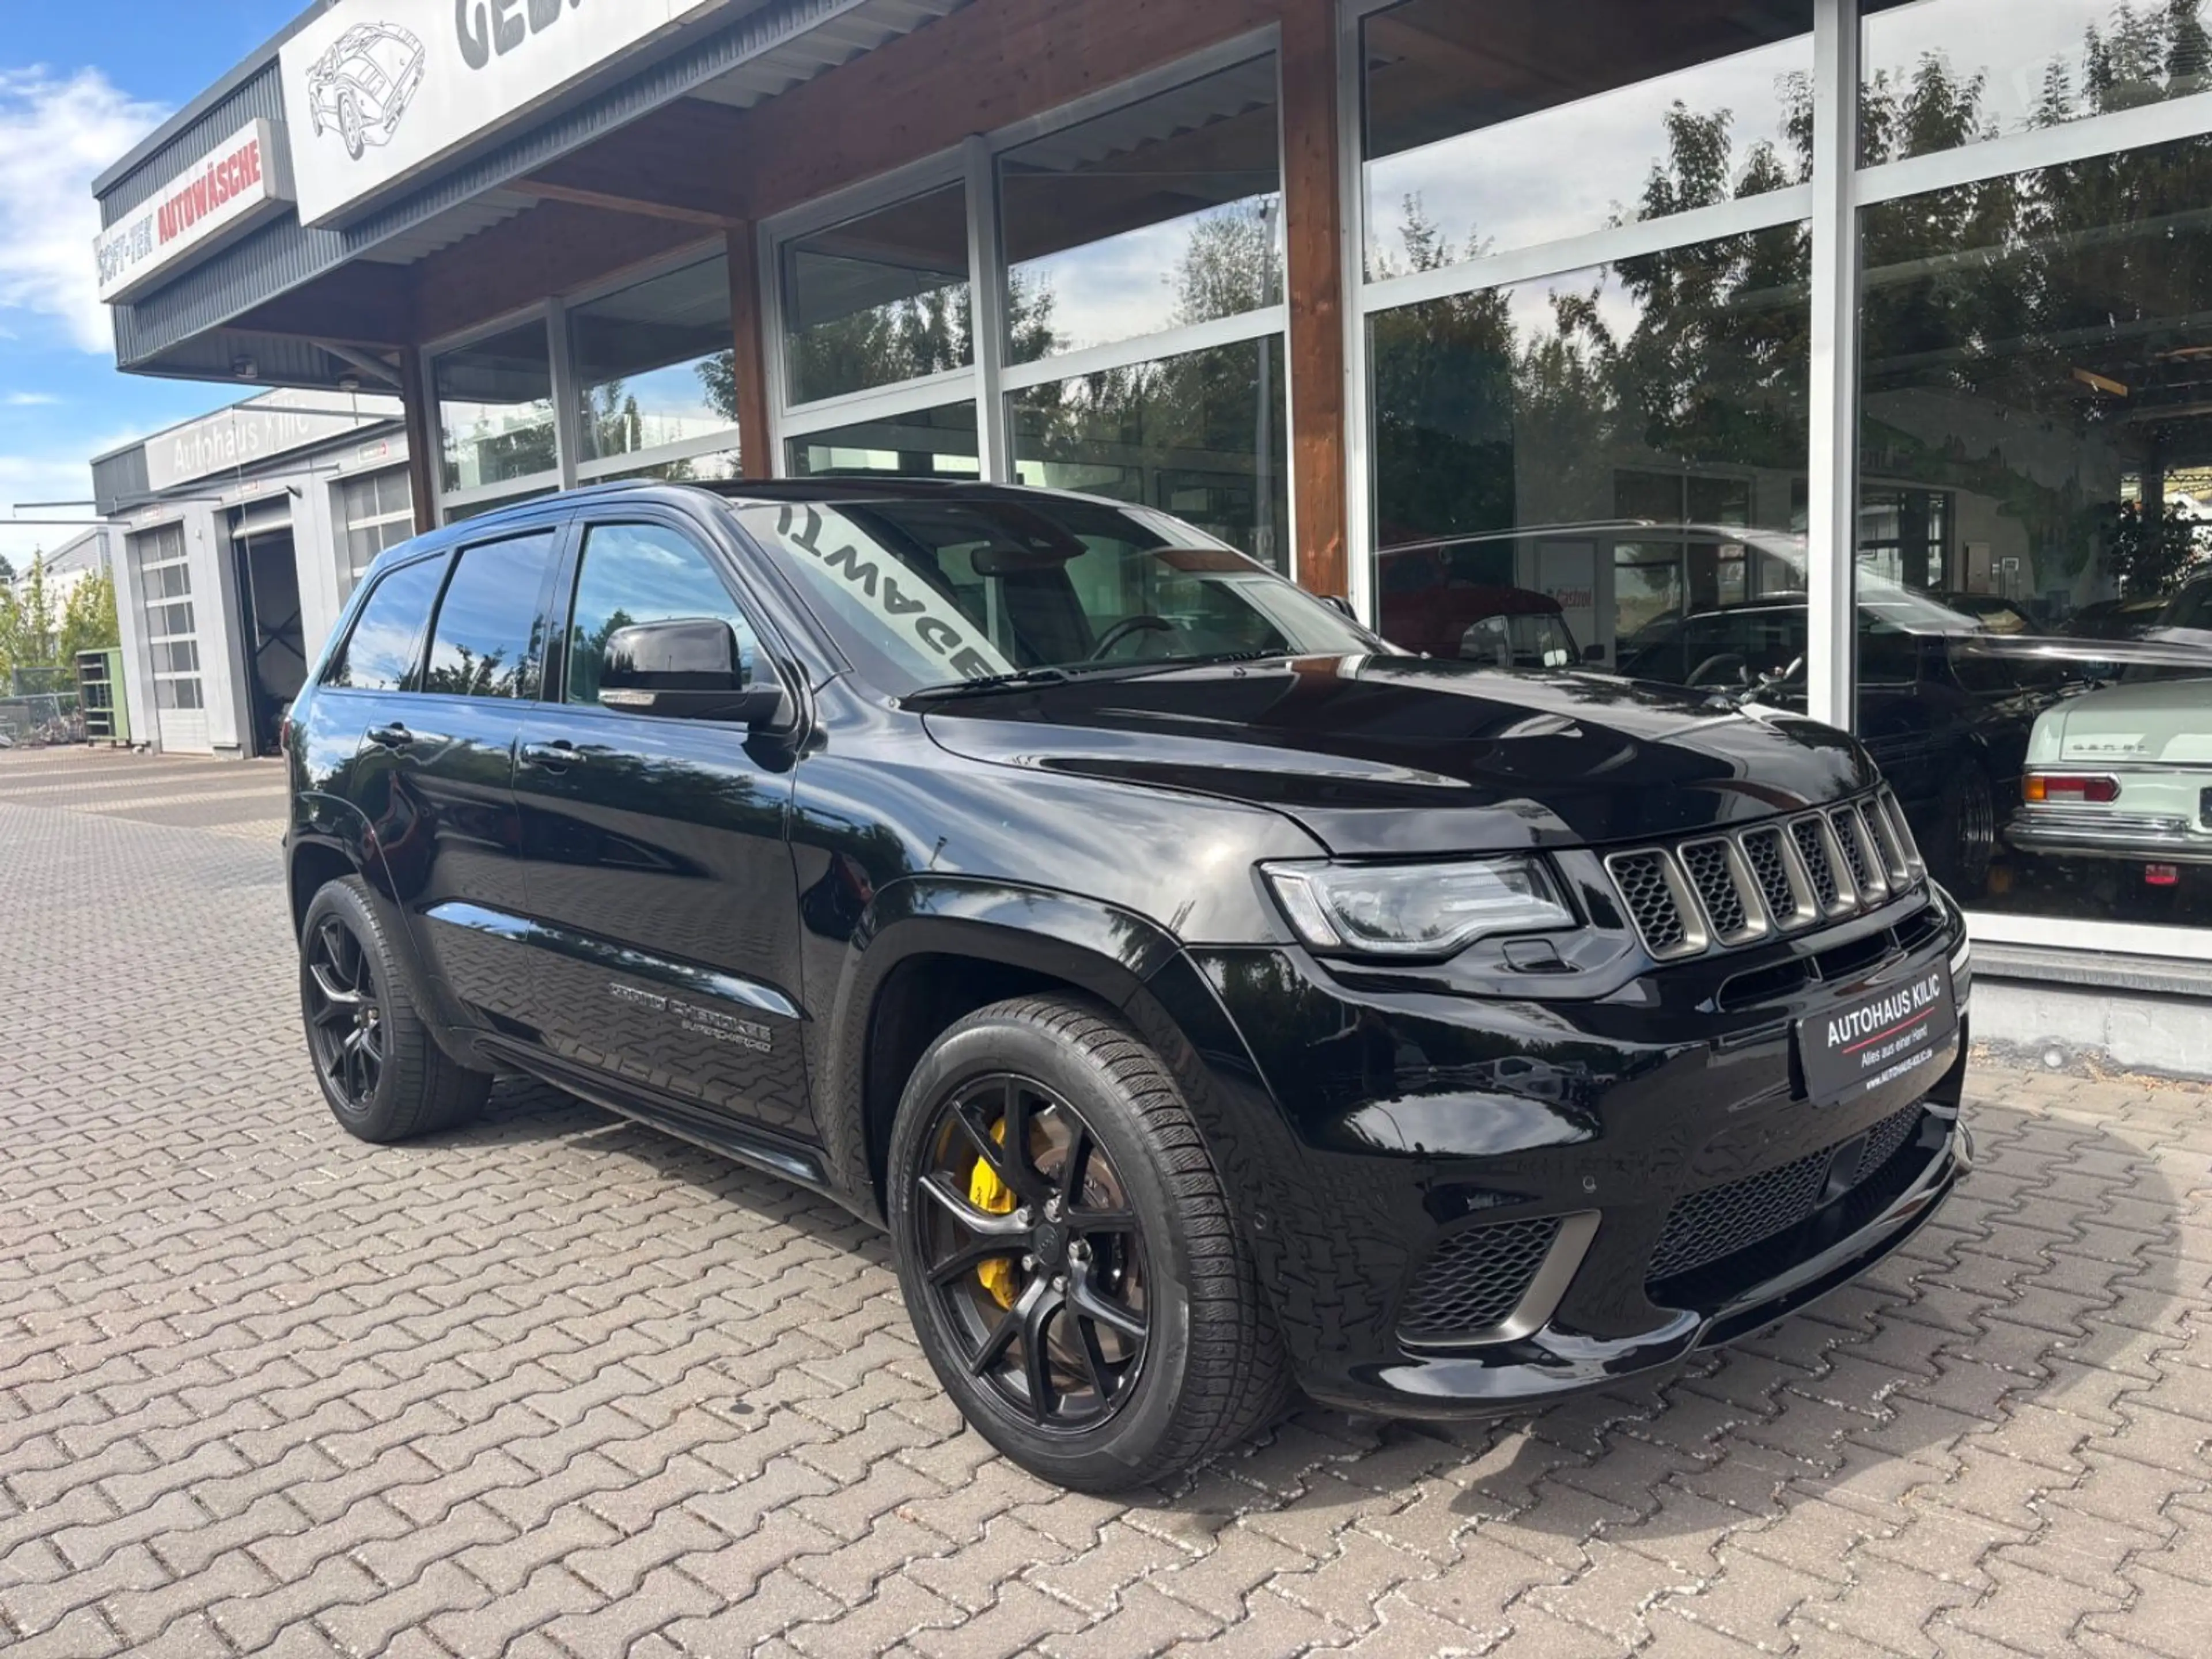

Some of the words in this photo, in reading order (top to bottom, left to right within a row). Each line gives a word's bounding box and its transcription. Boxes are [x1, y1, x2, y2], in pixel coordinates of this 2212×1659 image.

[157, 138, 261, 245] AUTOWÄSCHE
[175, 422, 259, 474] Autohaus
[1827, 990, 1911, 1048] AUTOHAUS
[1912, 973, 1941, 1009] KILIC
[1861, 1049, 1881, 1069] Alles
[1881, 1043, 1895, 1059] aus
[1895, 1035, 1911, 1051] einer
